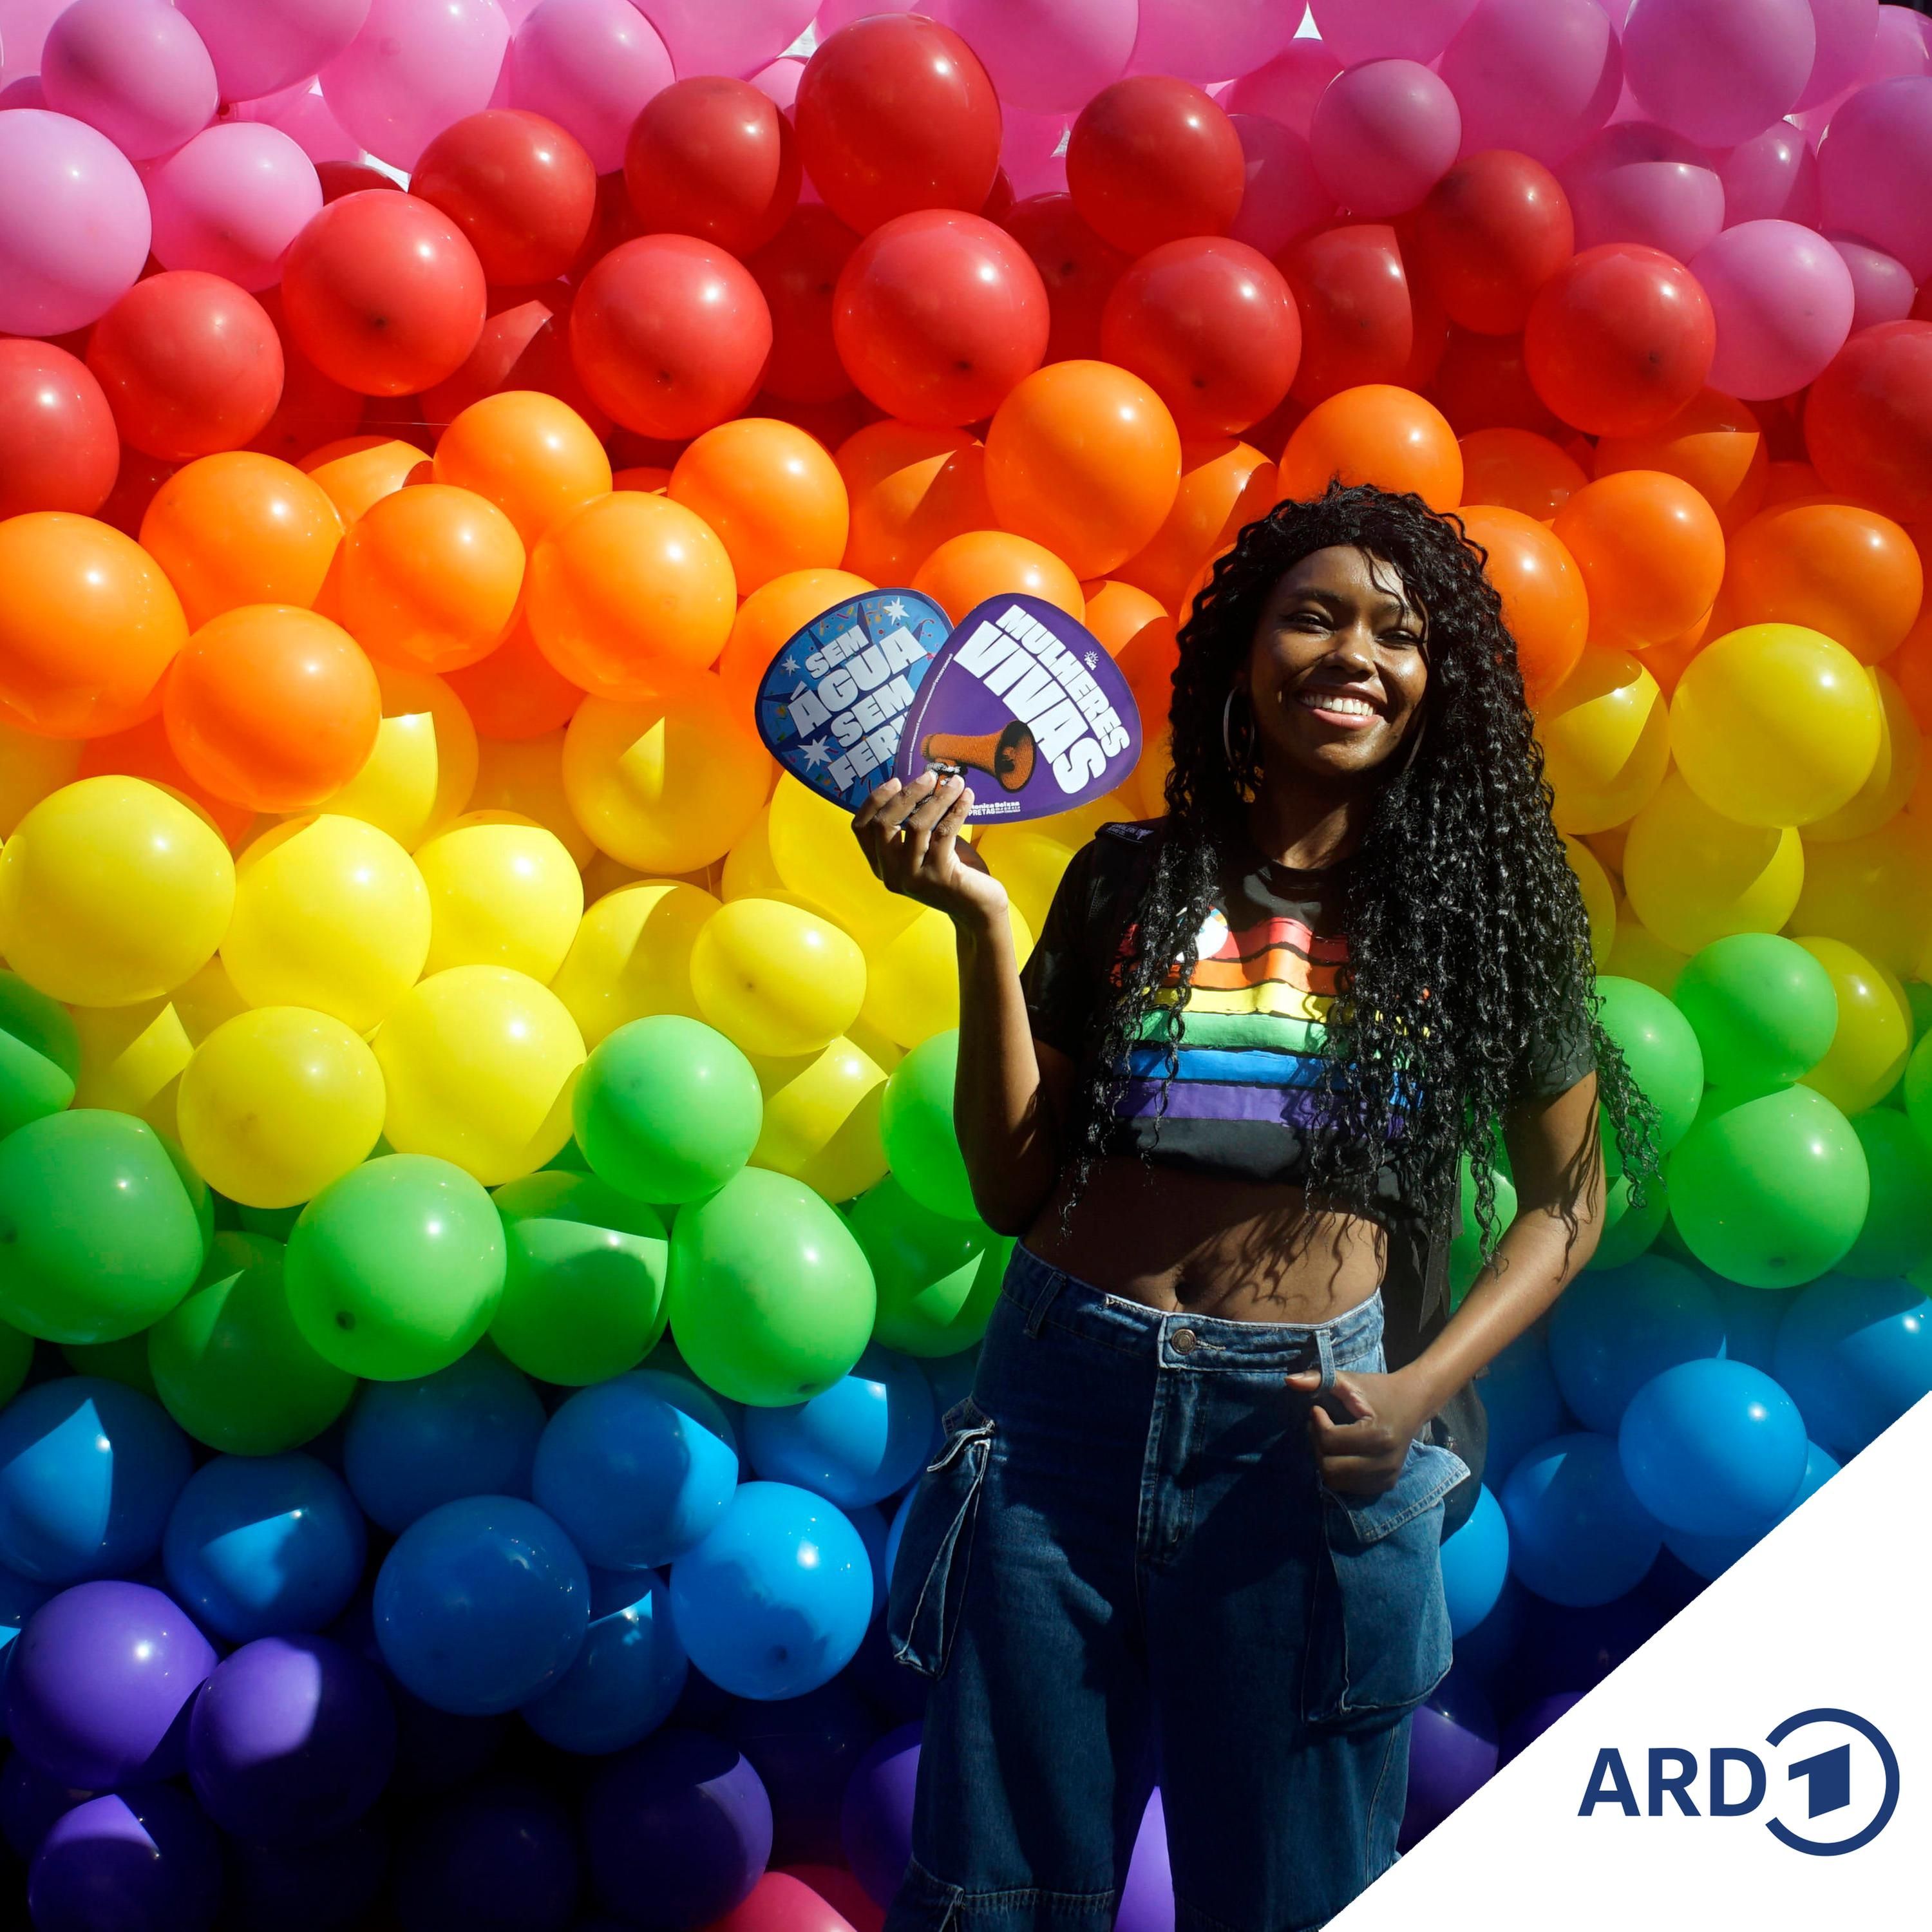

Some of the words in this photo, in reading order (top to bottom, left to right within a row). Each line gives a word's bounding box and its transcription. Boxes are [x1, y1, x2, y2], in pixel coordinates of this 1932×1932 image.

[788, 626, 928, 738] ÁGUA
[805, 625, 869, 679] SEM
[953, 620, 1106, 794] VIVAS
[996, 604, 1130, 758] MULHERES
[831, 674, 915, 748] SEM
